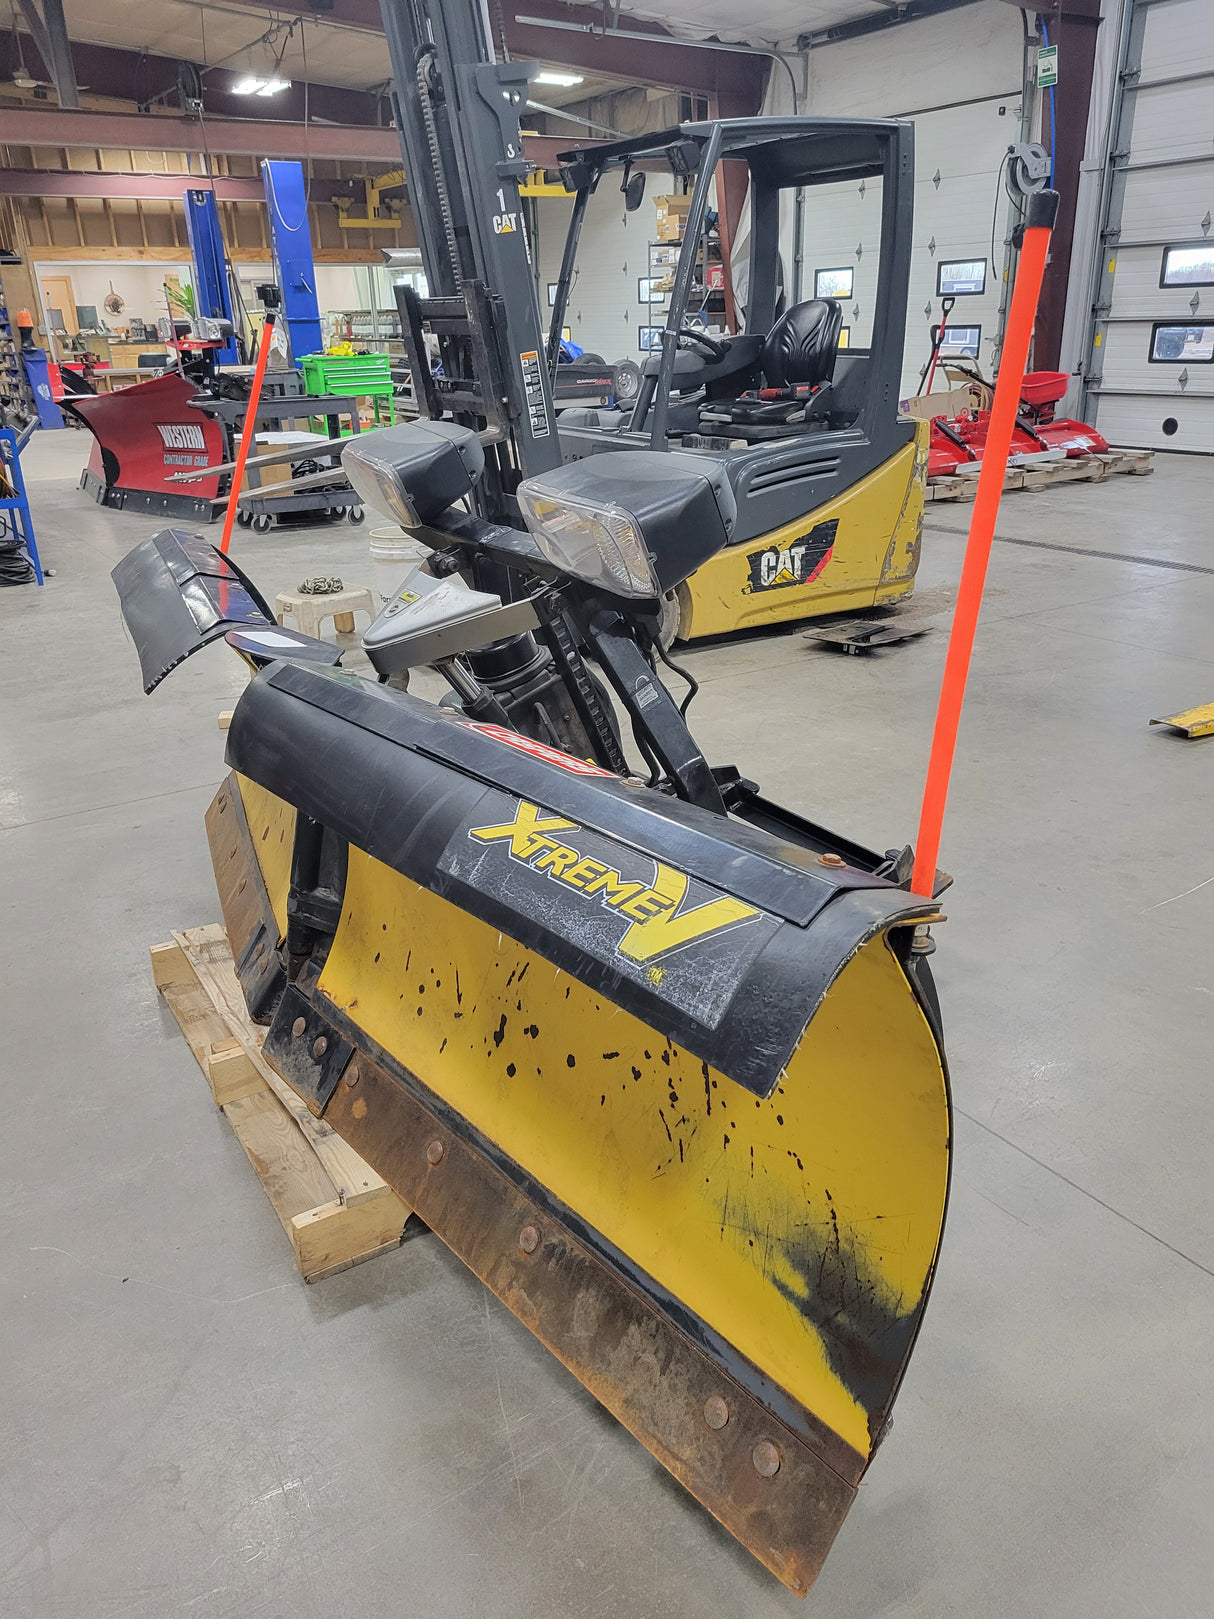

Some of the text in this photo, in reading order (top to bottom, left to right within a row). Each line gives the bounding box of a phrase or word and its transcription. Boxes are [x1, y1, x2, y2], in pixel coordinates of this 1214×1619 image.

[496, 188, 506, 212] 1
[492, 213, 517, 234] CAT
[157, 425, 205, 449] WESTERN
[164, 454, 209, 467] CONTRACTOR GRADE
[761, 546, 807, 586] CAT
